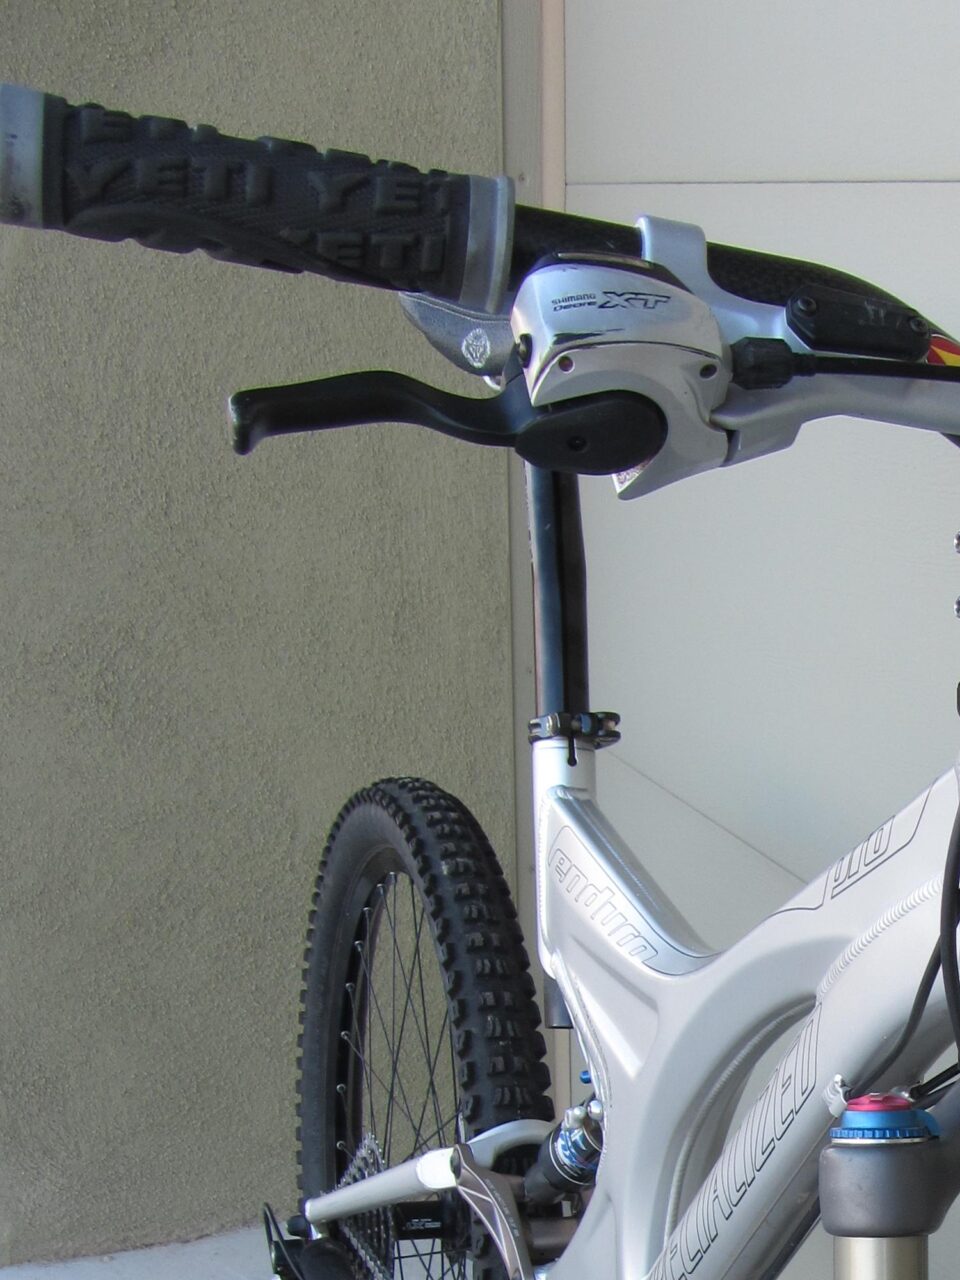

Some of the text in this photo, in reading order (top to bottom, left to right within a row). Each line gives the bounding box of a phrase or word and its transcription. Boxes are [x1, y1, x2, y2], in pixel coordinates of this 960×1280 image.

[66, 157, 275, 202] YETI
[598, 291, 671, 309] XT
[550, 848, 659, 963] enduro
